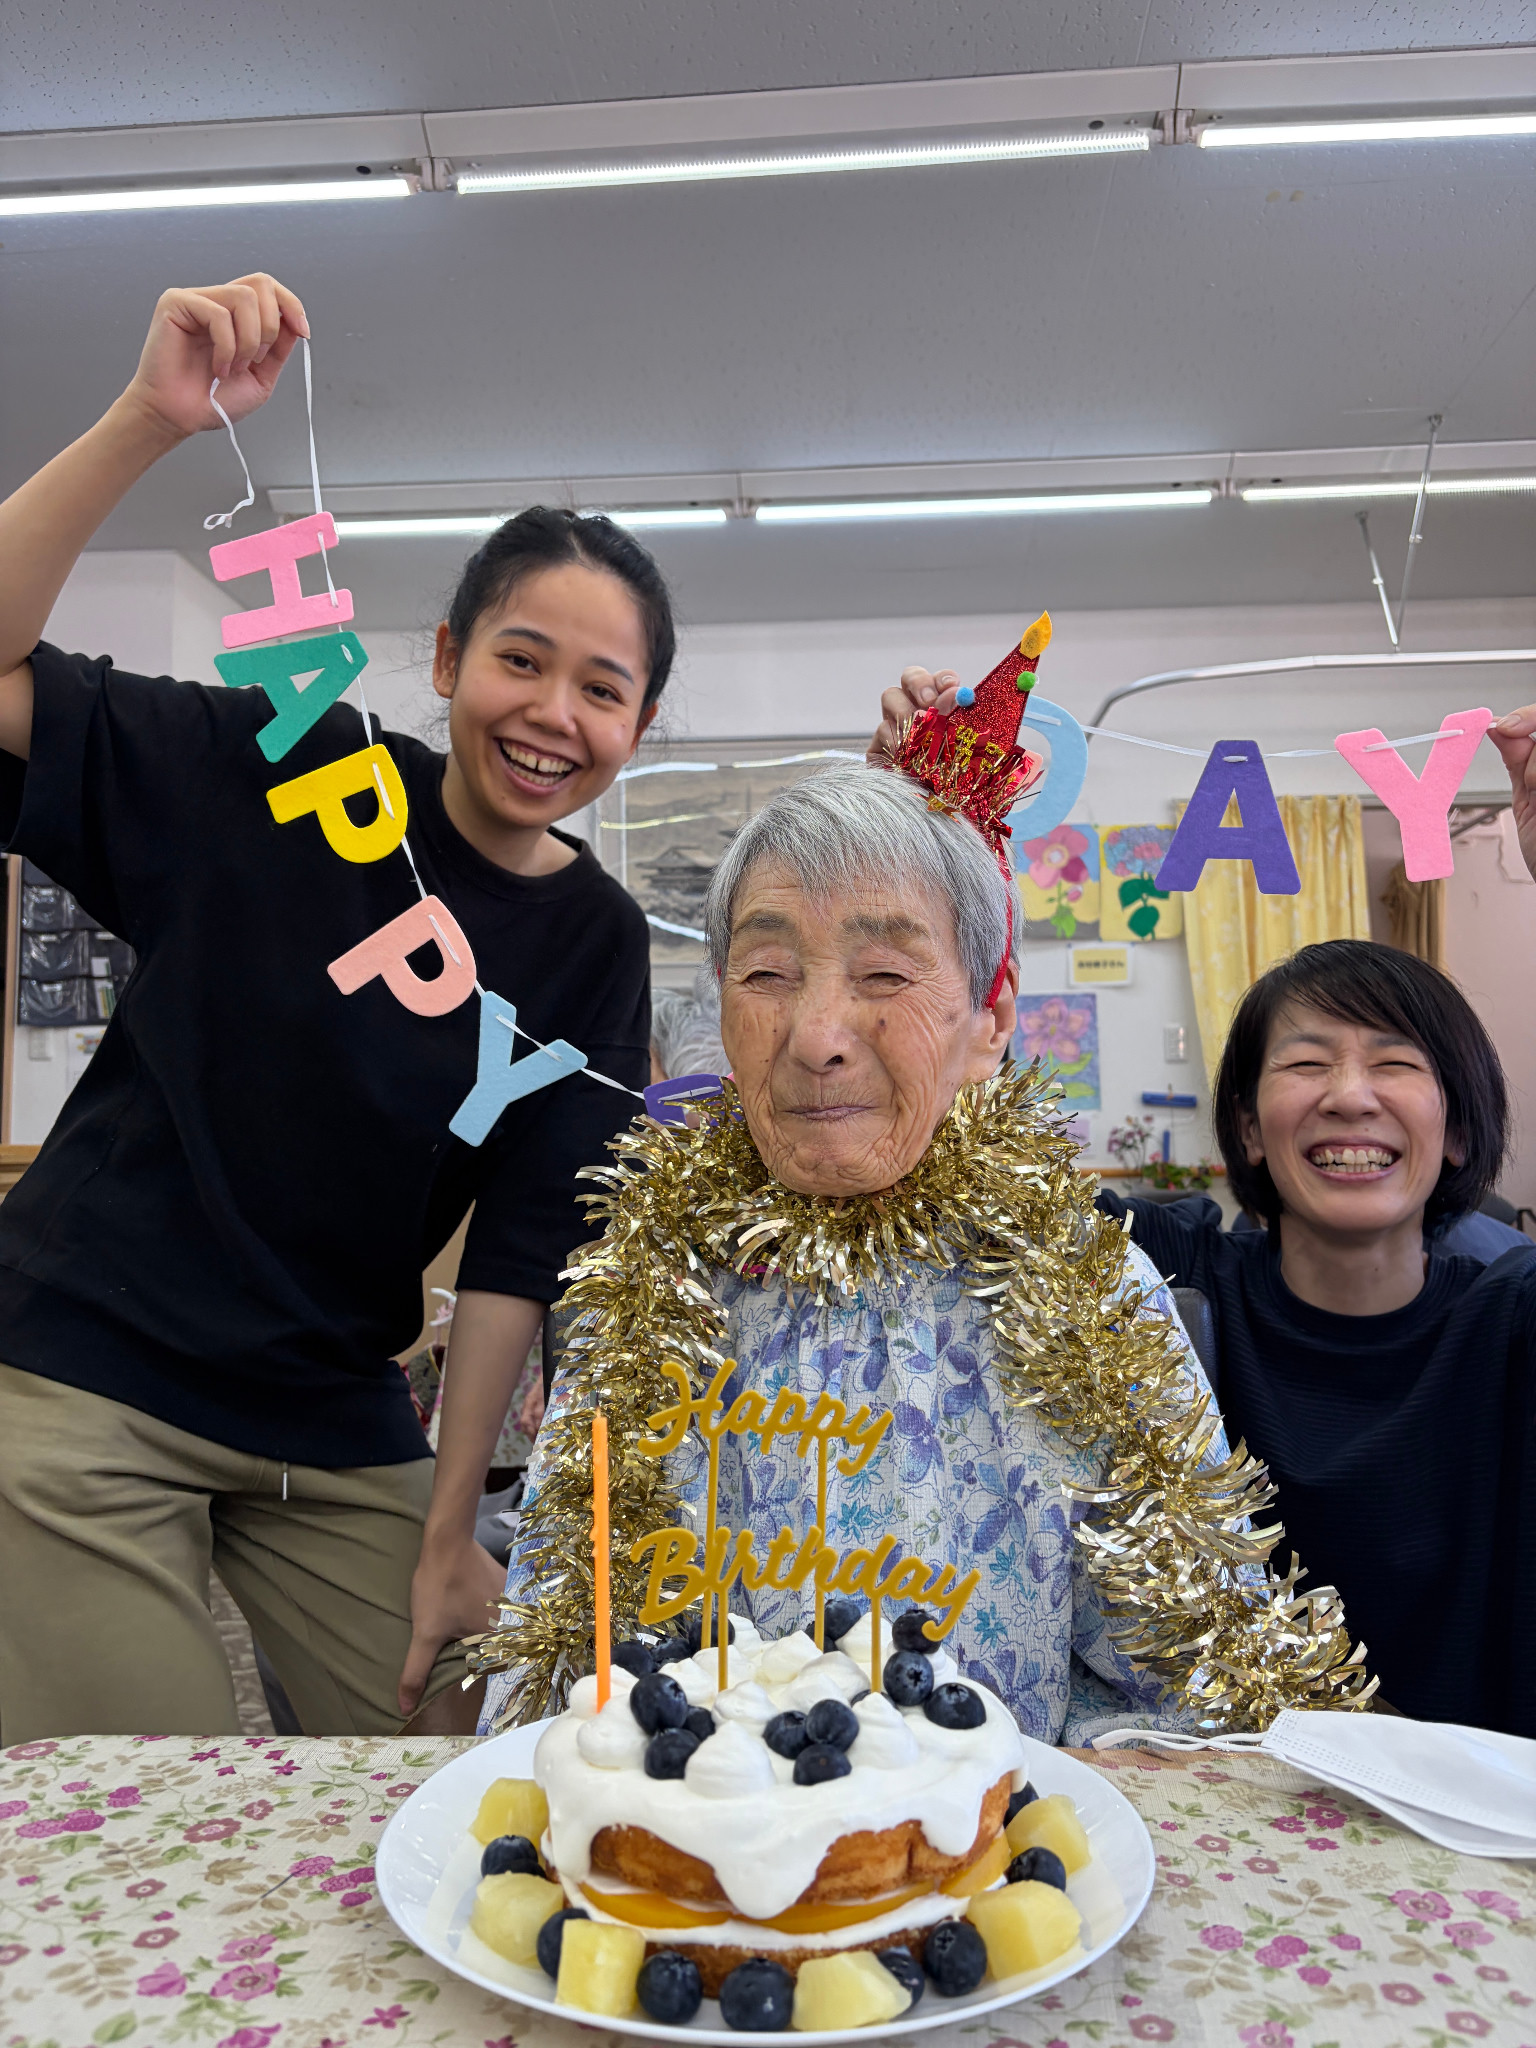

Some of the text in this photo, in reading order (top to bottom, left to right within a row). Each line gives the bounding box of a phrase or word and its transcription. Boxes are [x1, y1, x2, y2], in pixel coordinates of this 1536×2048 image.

[209, 511, 587, 1146] HAPPY
[638, 1359, 893, 1477] Happy
[631, 1526, 982, 1642] Birthday
